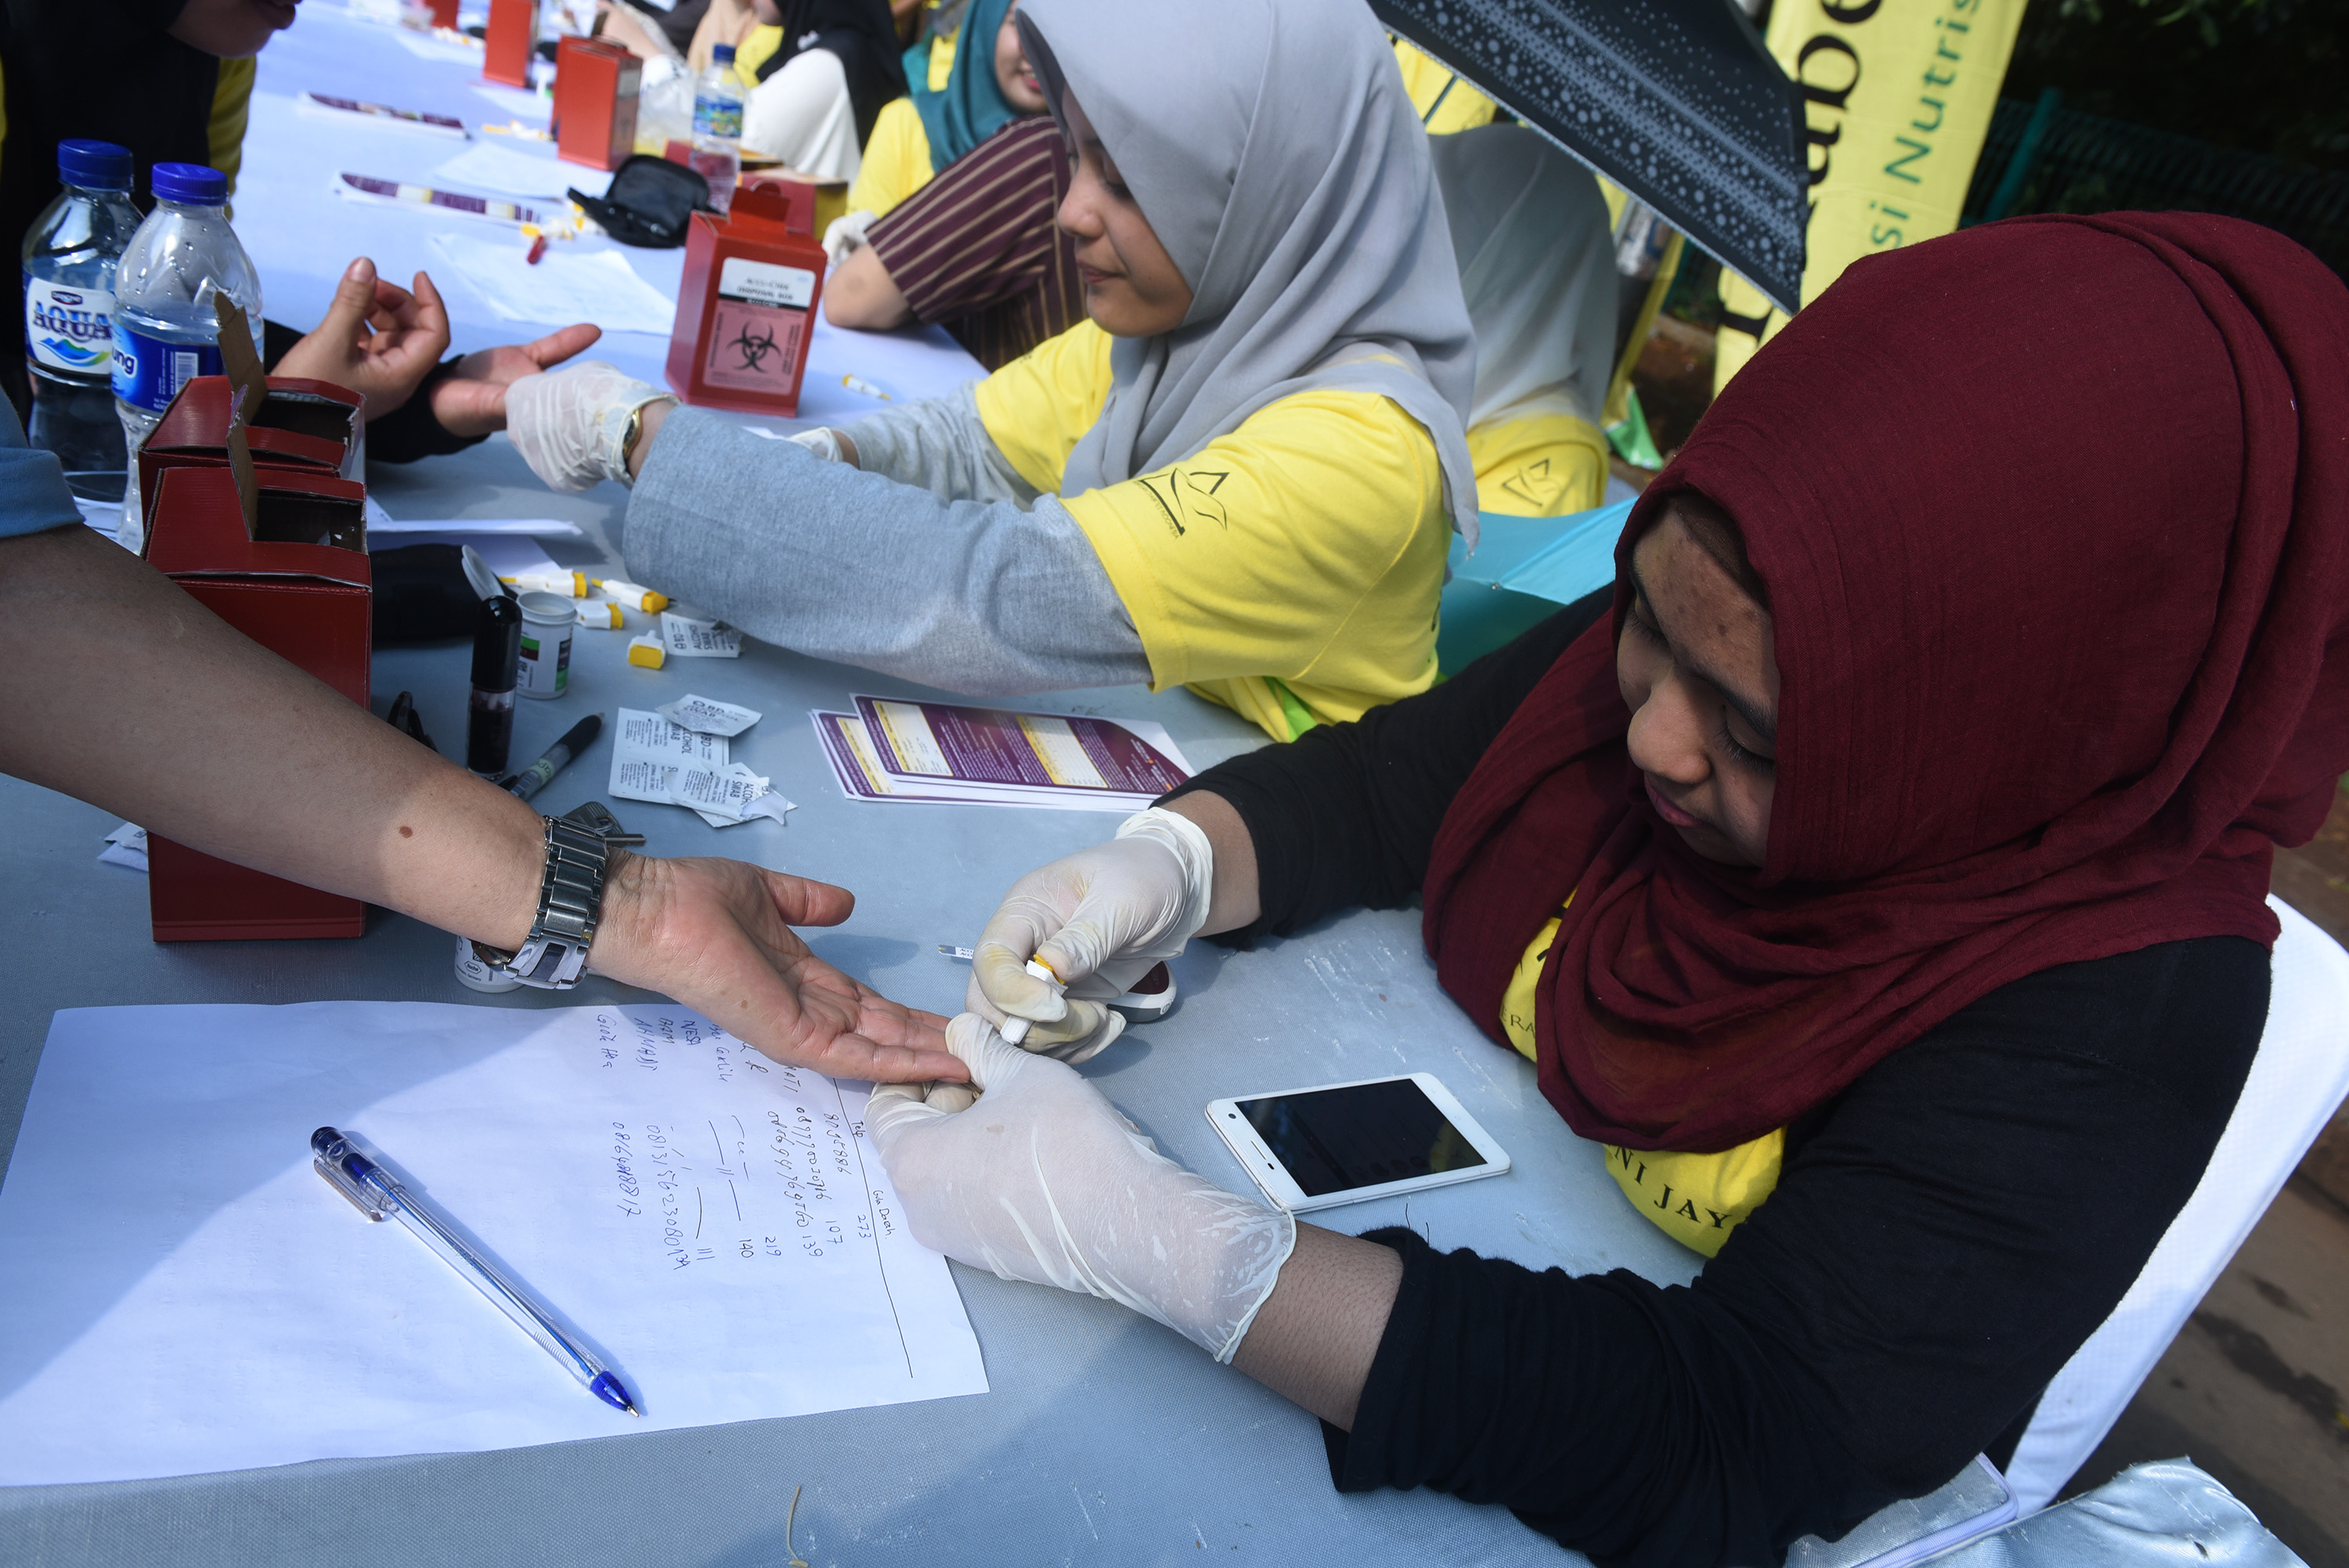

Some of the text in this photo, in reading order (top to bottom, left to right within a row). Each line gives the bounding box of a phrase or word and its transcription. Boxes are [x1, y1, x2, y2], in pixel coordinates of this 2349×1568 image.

[33, 300, 113, 343] AQUA
[680, 725, 693, 755] LCOHOL
[729, 780, 742, 799] SWAB
[1607, 1143, 1750, 1230] NI JAY
[825, 1220, 843, 1245] 107
[857, 1214, 871, 1239] 273
[738, 1238, 754, 1259] 140
[764, 1235, 781, 1257] 219
[802, 1235, 823, 1257] 139
